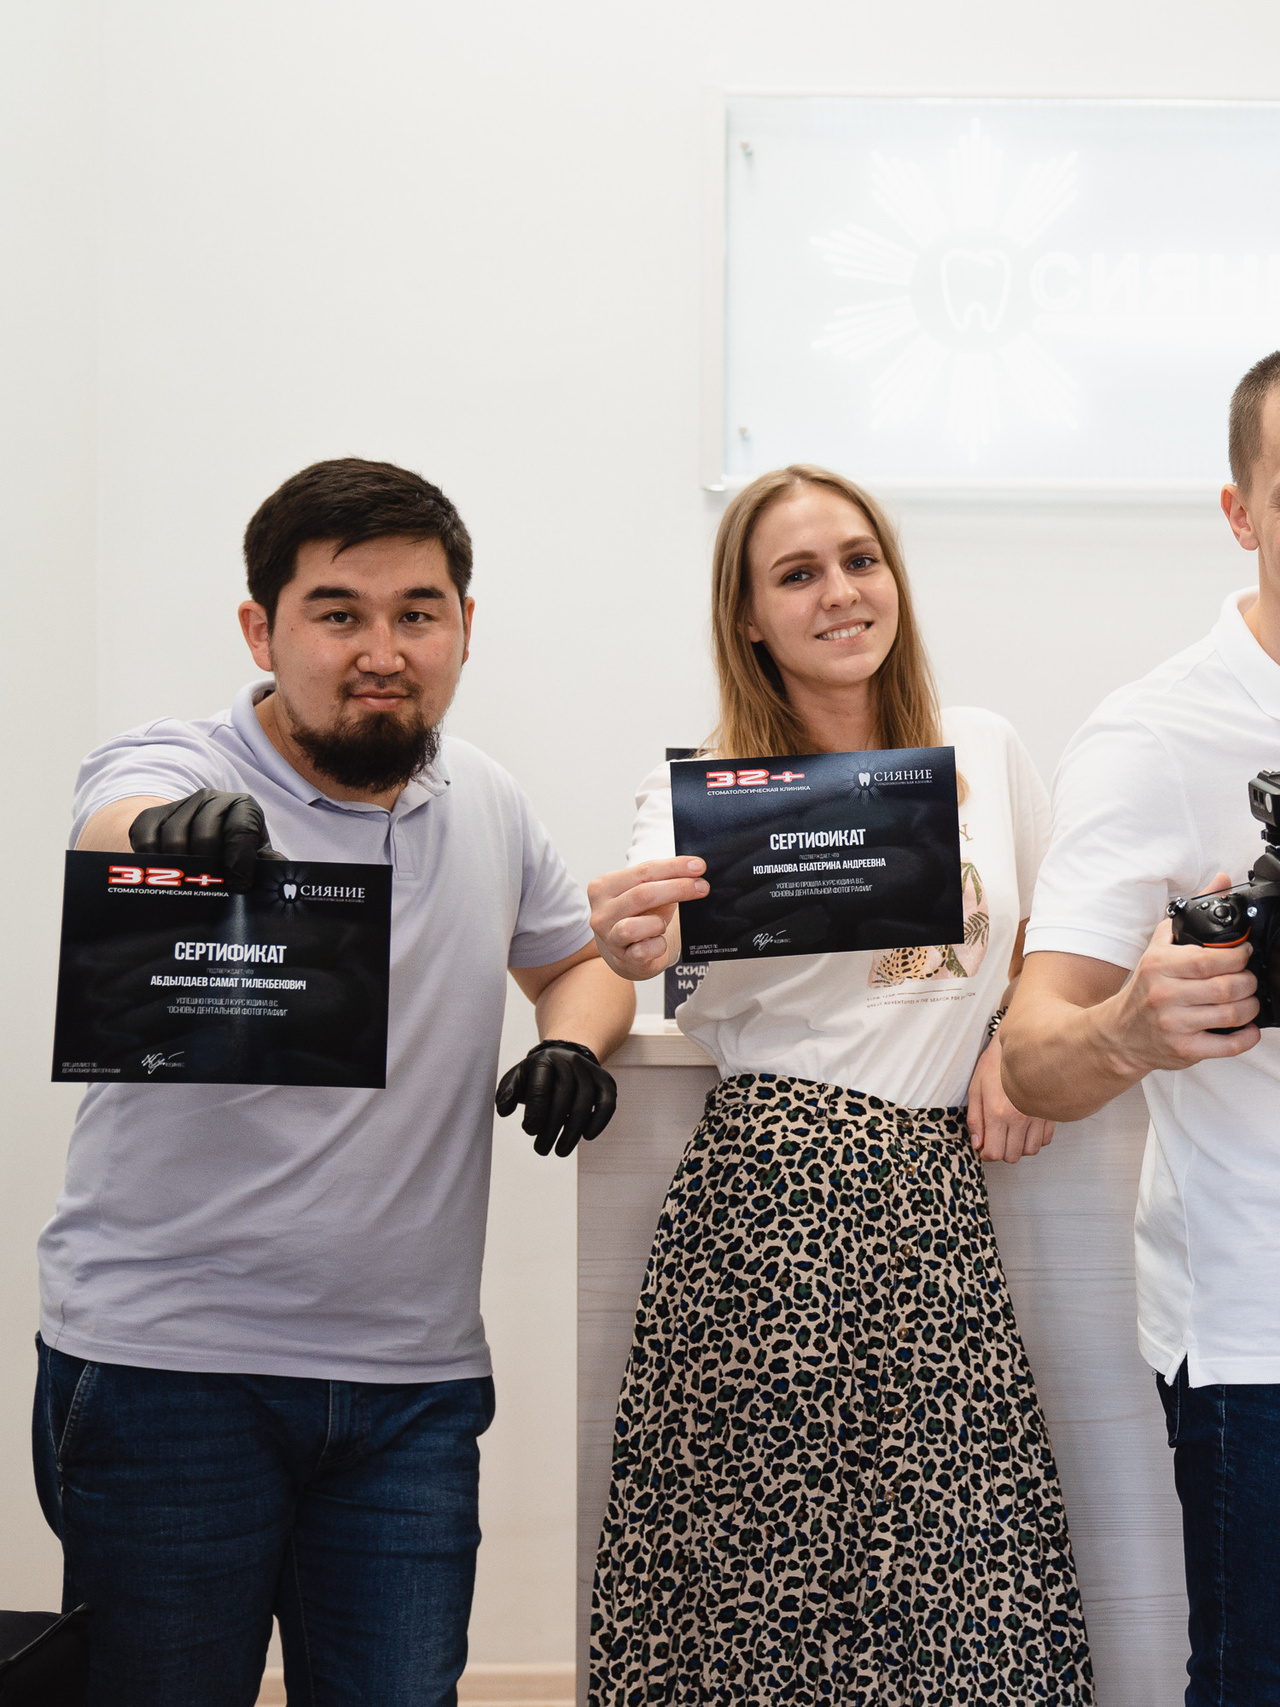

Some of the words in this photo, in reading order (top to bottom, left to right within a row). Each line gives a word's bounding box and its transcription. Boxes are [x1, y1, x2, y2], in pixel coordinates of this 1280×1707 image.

[706, 769, 805, 788] 32+
[874, 769, 932, 781] СИЯНИЕ
[707, 788, 778, 796] СТОМАТОЛОГИЧЕСКАЯ
[770, 829, 866, 850] СЕРТИФИКАТ
[753, 864, 798, 874] КОЛПАКОВА
[799, 861, 841, 871] ЕКАТЕРИНА
[842, 858, 886, 869] АНДРЕЕВНА
[108, 866, 224, 886] 32+
[108, 887, 192, 896] СТОМАТОЛОГИЧЕСКАЯ
[300, 885, 365, 898] СИЯНИЕ
[795, 888, 832, 897] ДЕНТАЛЬНОЙ
[174, 942, 287, 963] СЕРТИФИКАТ
[150, 976, 208, 986] АБДЫЛДАЕВ
[210, 977, 239, 988] САМАТ
[241, 978, 306, 990] ТИЛЕКБЕКОВИЧ
[678, 980, 694, 989] НА
[176, 997, 204, 1005] УСПЕШНО
[196, 1006, 240, 1015] ДЕНТАЛЬНОЙ
